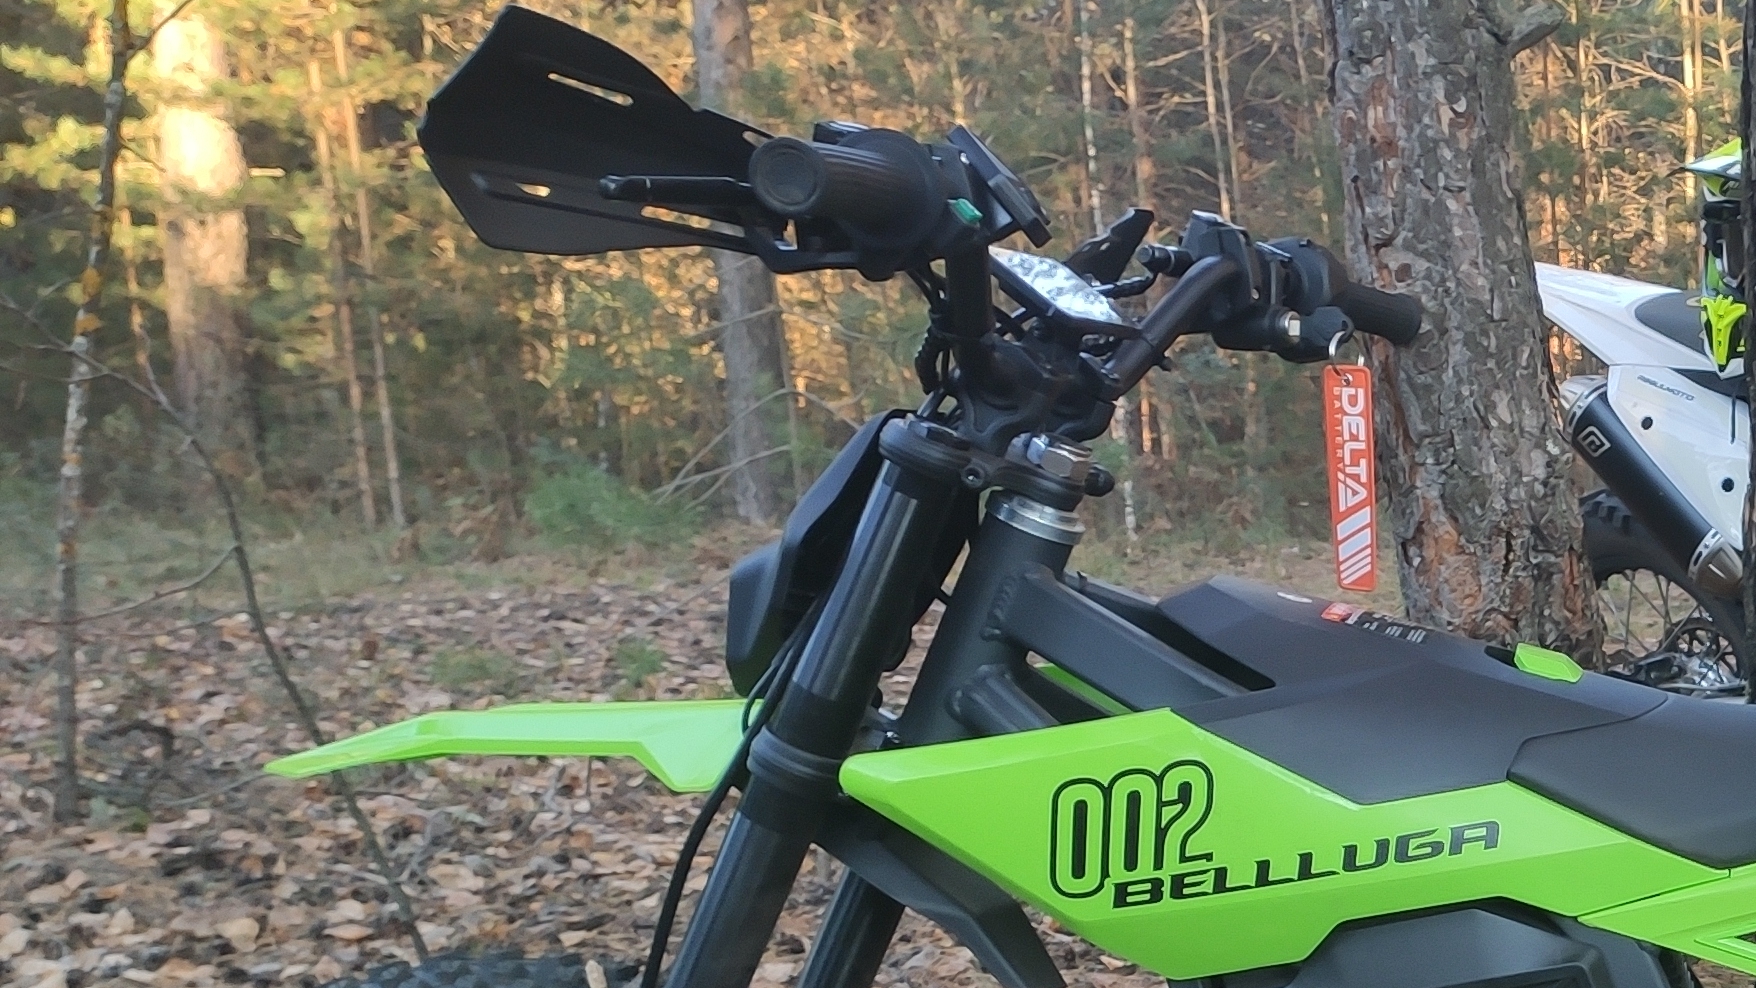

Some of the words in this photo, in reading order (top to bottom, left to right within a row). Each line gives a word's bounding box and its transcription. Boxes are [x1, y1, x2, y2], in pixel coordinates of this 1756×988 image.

[1332, 386, 1344, 469] BATTERY
[1337, 387, 1368, 512] DELTA
[1050, 759, 1213, 898] 002
[1111, 820, 1501, 909] BELLLUGA
